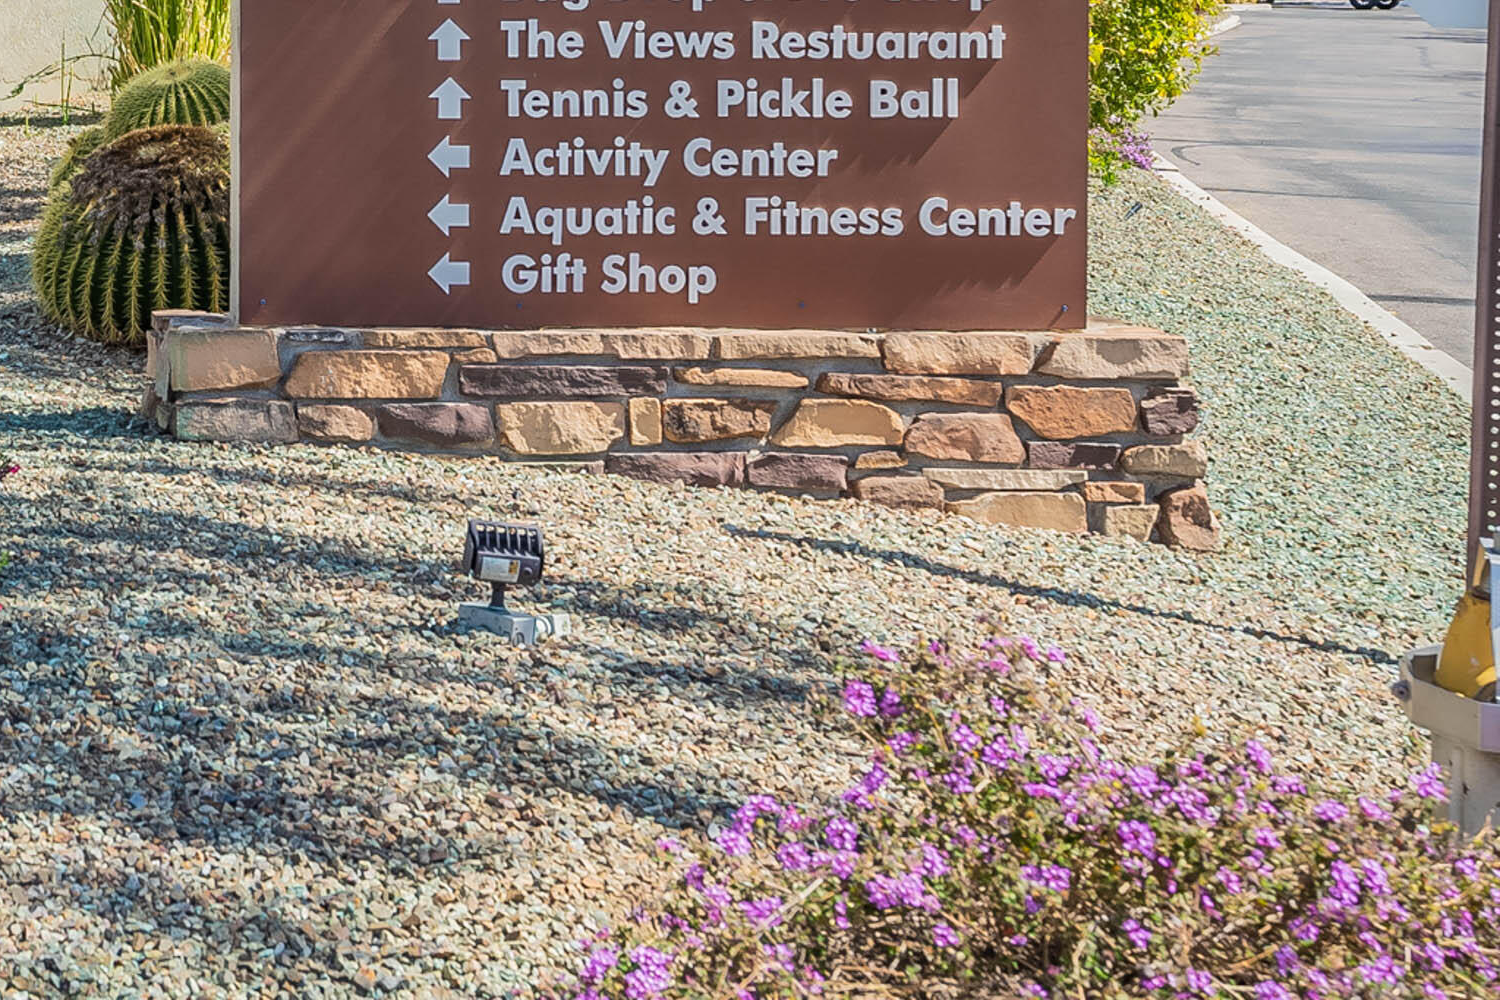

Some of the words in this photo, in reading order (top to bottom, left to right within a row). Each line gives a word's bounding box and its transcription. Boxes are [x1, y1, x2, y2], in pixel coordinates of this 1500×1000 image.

[501, 19, 584, 58] The
[599, 20, 735, 59] Views
[752, 21, 1006, 59] Restuarant
[501, 78, 647, 118] Tennis
[665, 80, 699, 117] &
[718, 78, 852, 118] Pickle
[871, 78, 958, 118] Ball
[500, 136, 669, 186] Activity
[684, 138, 838, 177] Center
[500, 196, 675, 245] Aquatic
[693, 198, 727, 235] &
[746, 196, 903, 235] Fitness
[920, 197, 1076, 236] Center
[502, 253, 586, 293] Gift
[601, 253, 716, 303] Shop
